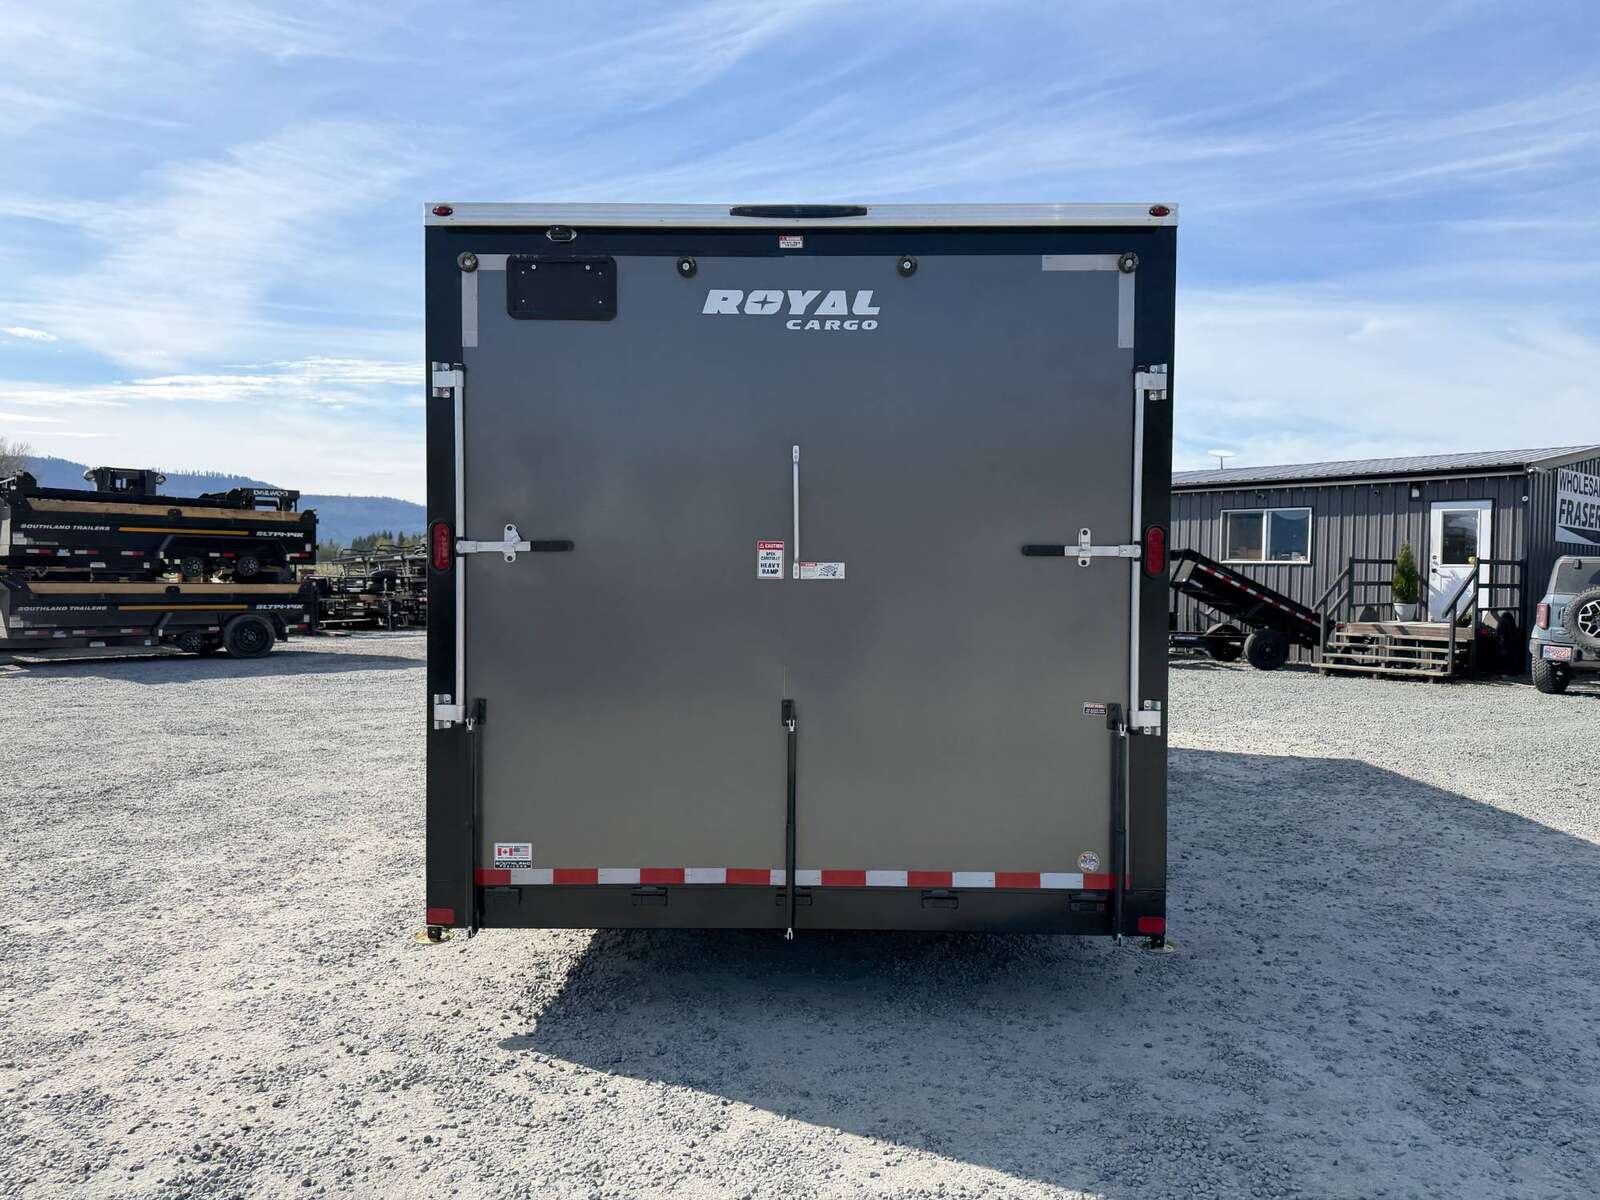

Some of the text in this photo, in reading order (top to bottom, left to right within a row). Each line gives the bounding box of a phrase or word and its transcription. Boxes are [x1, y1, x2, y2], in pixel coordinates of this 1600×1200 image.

[702, 289, 881, 315] ROYAL
[786, 319, 879, 331] CARGO
[1559, 471, 1600, 498] WHOLESA
